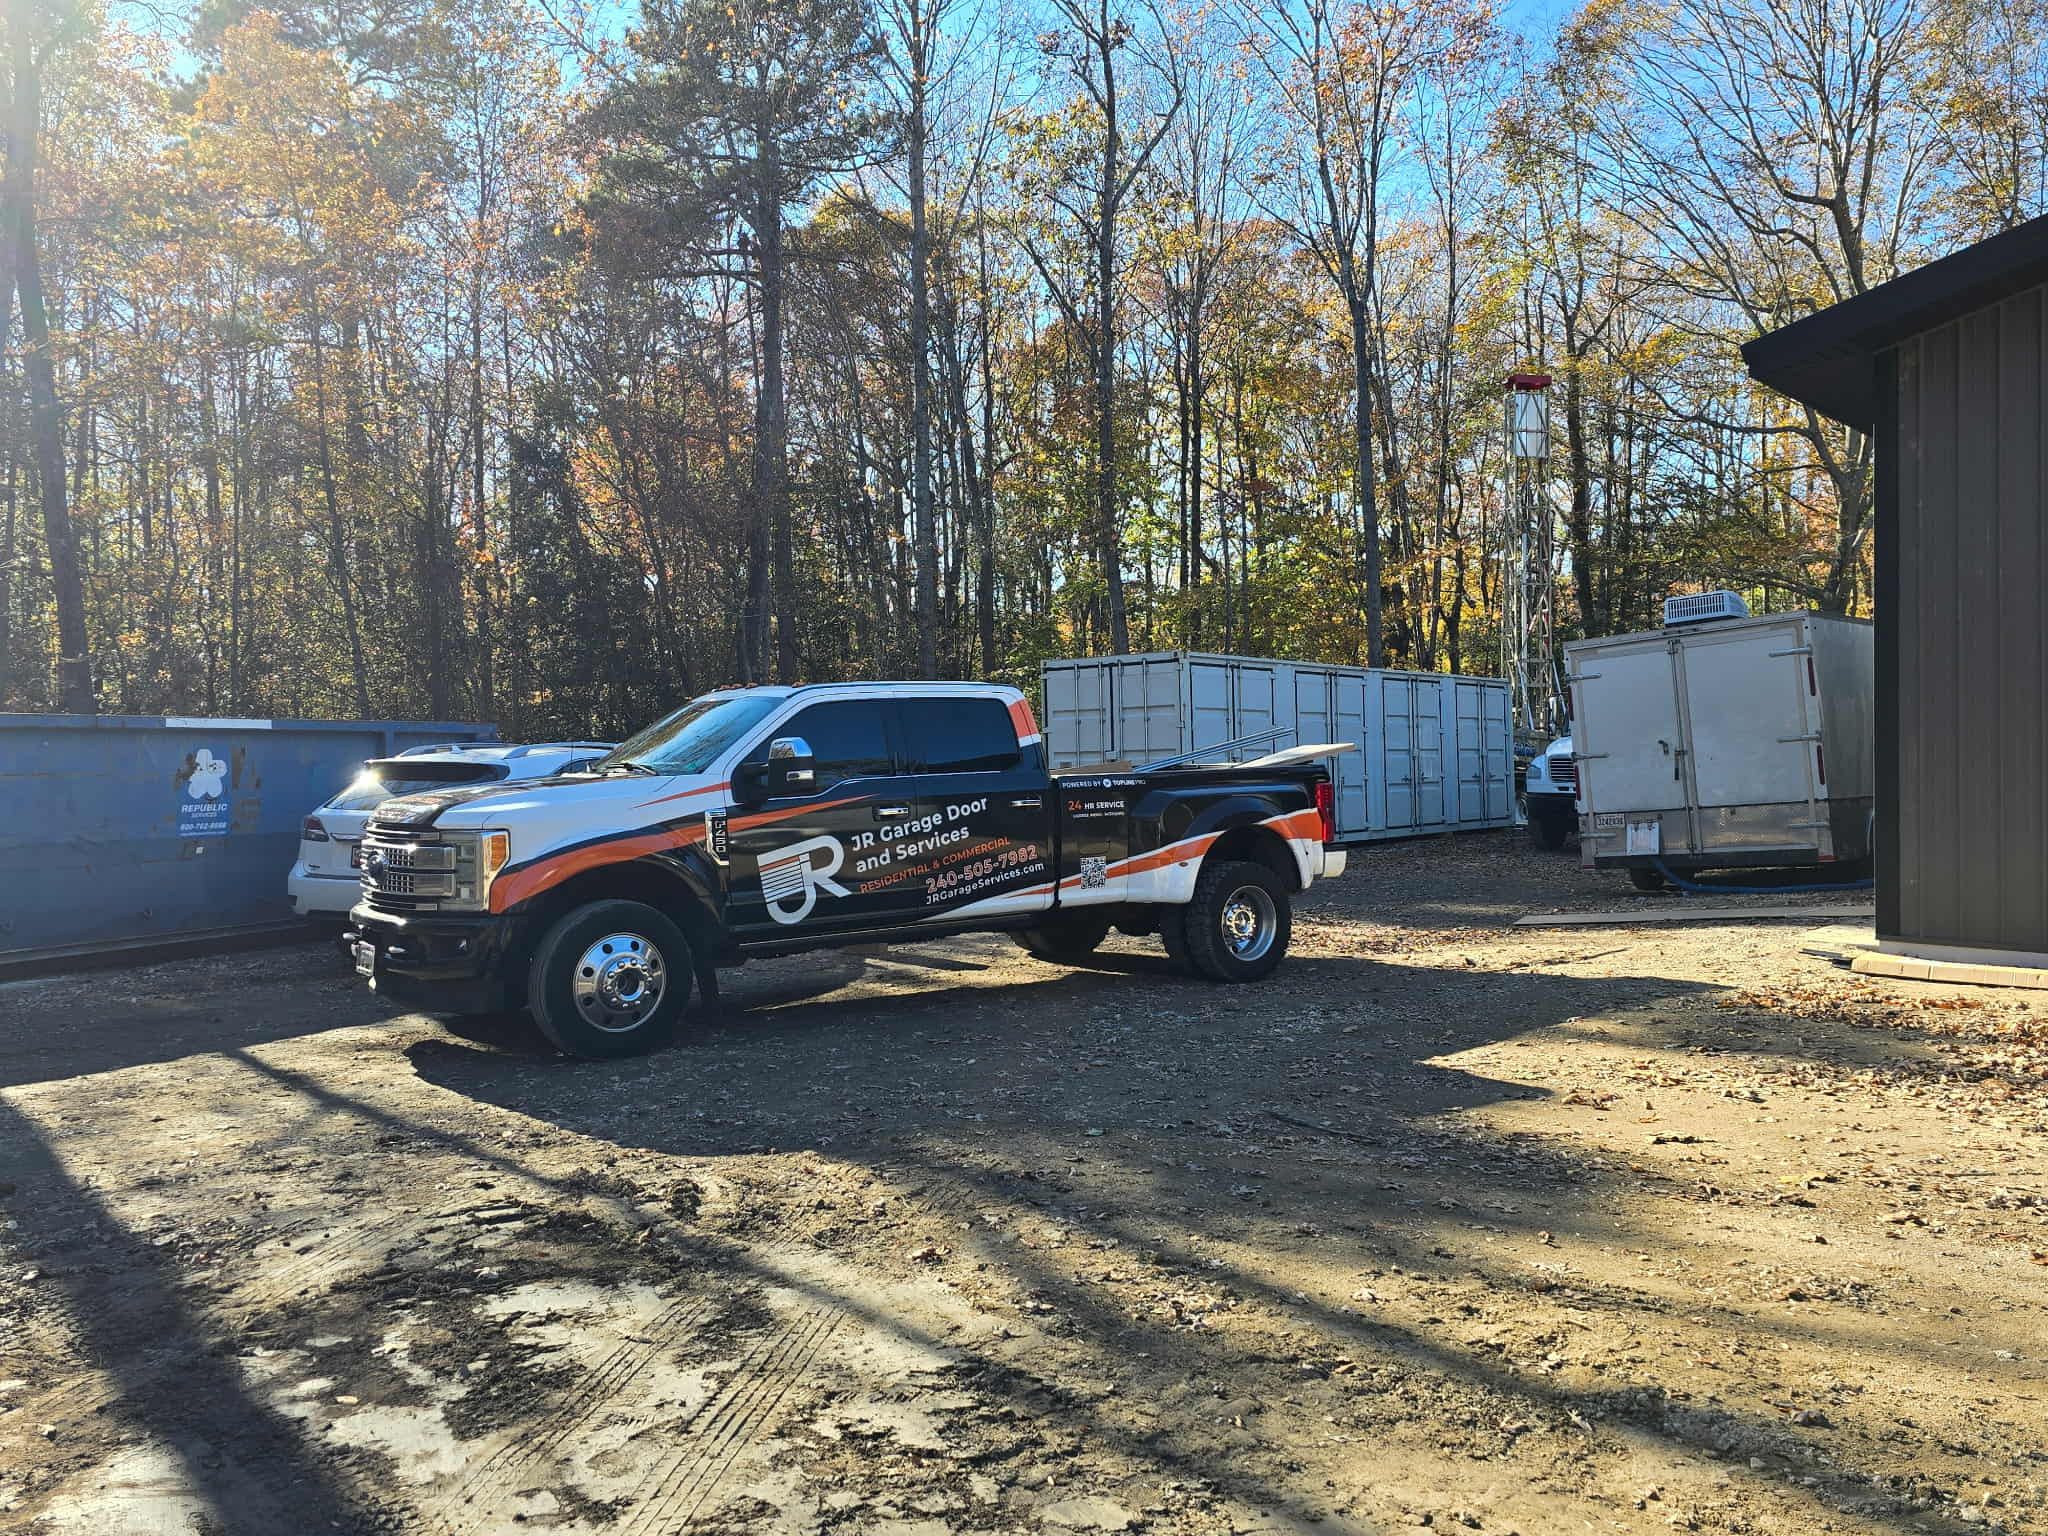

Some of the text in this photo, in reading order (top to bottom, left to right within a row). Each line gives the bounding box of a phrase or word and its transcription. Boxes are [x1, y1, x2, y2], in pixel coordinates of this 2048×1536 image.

[181, 803, 228, 813] REPUBLIC
[851, 798, 988, 852] JR Garage Door
[1067, 800, 1125, 811] 24 HR SERVICE
[856, 826, 970, 873] and Services
[860, 837, 1011, 894] RESIDENTIAL & COMMERCIAL
[925, 844, 1038, 894] 240-505-7982
[925, 862, 1045, 905] JRGarageServices.com
